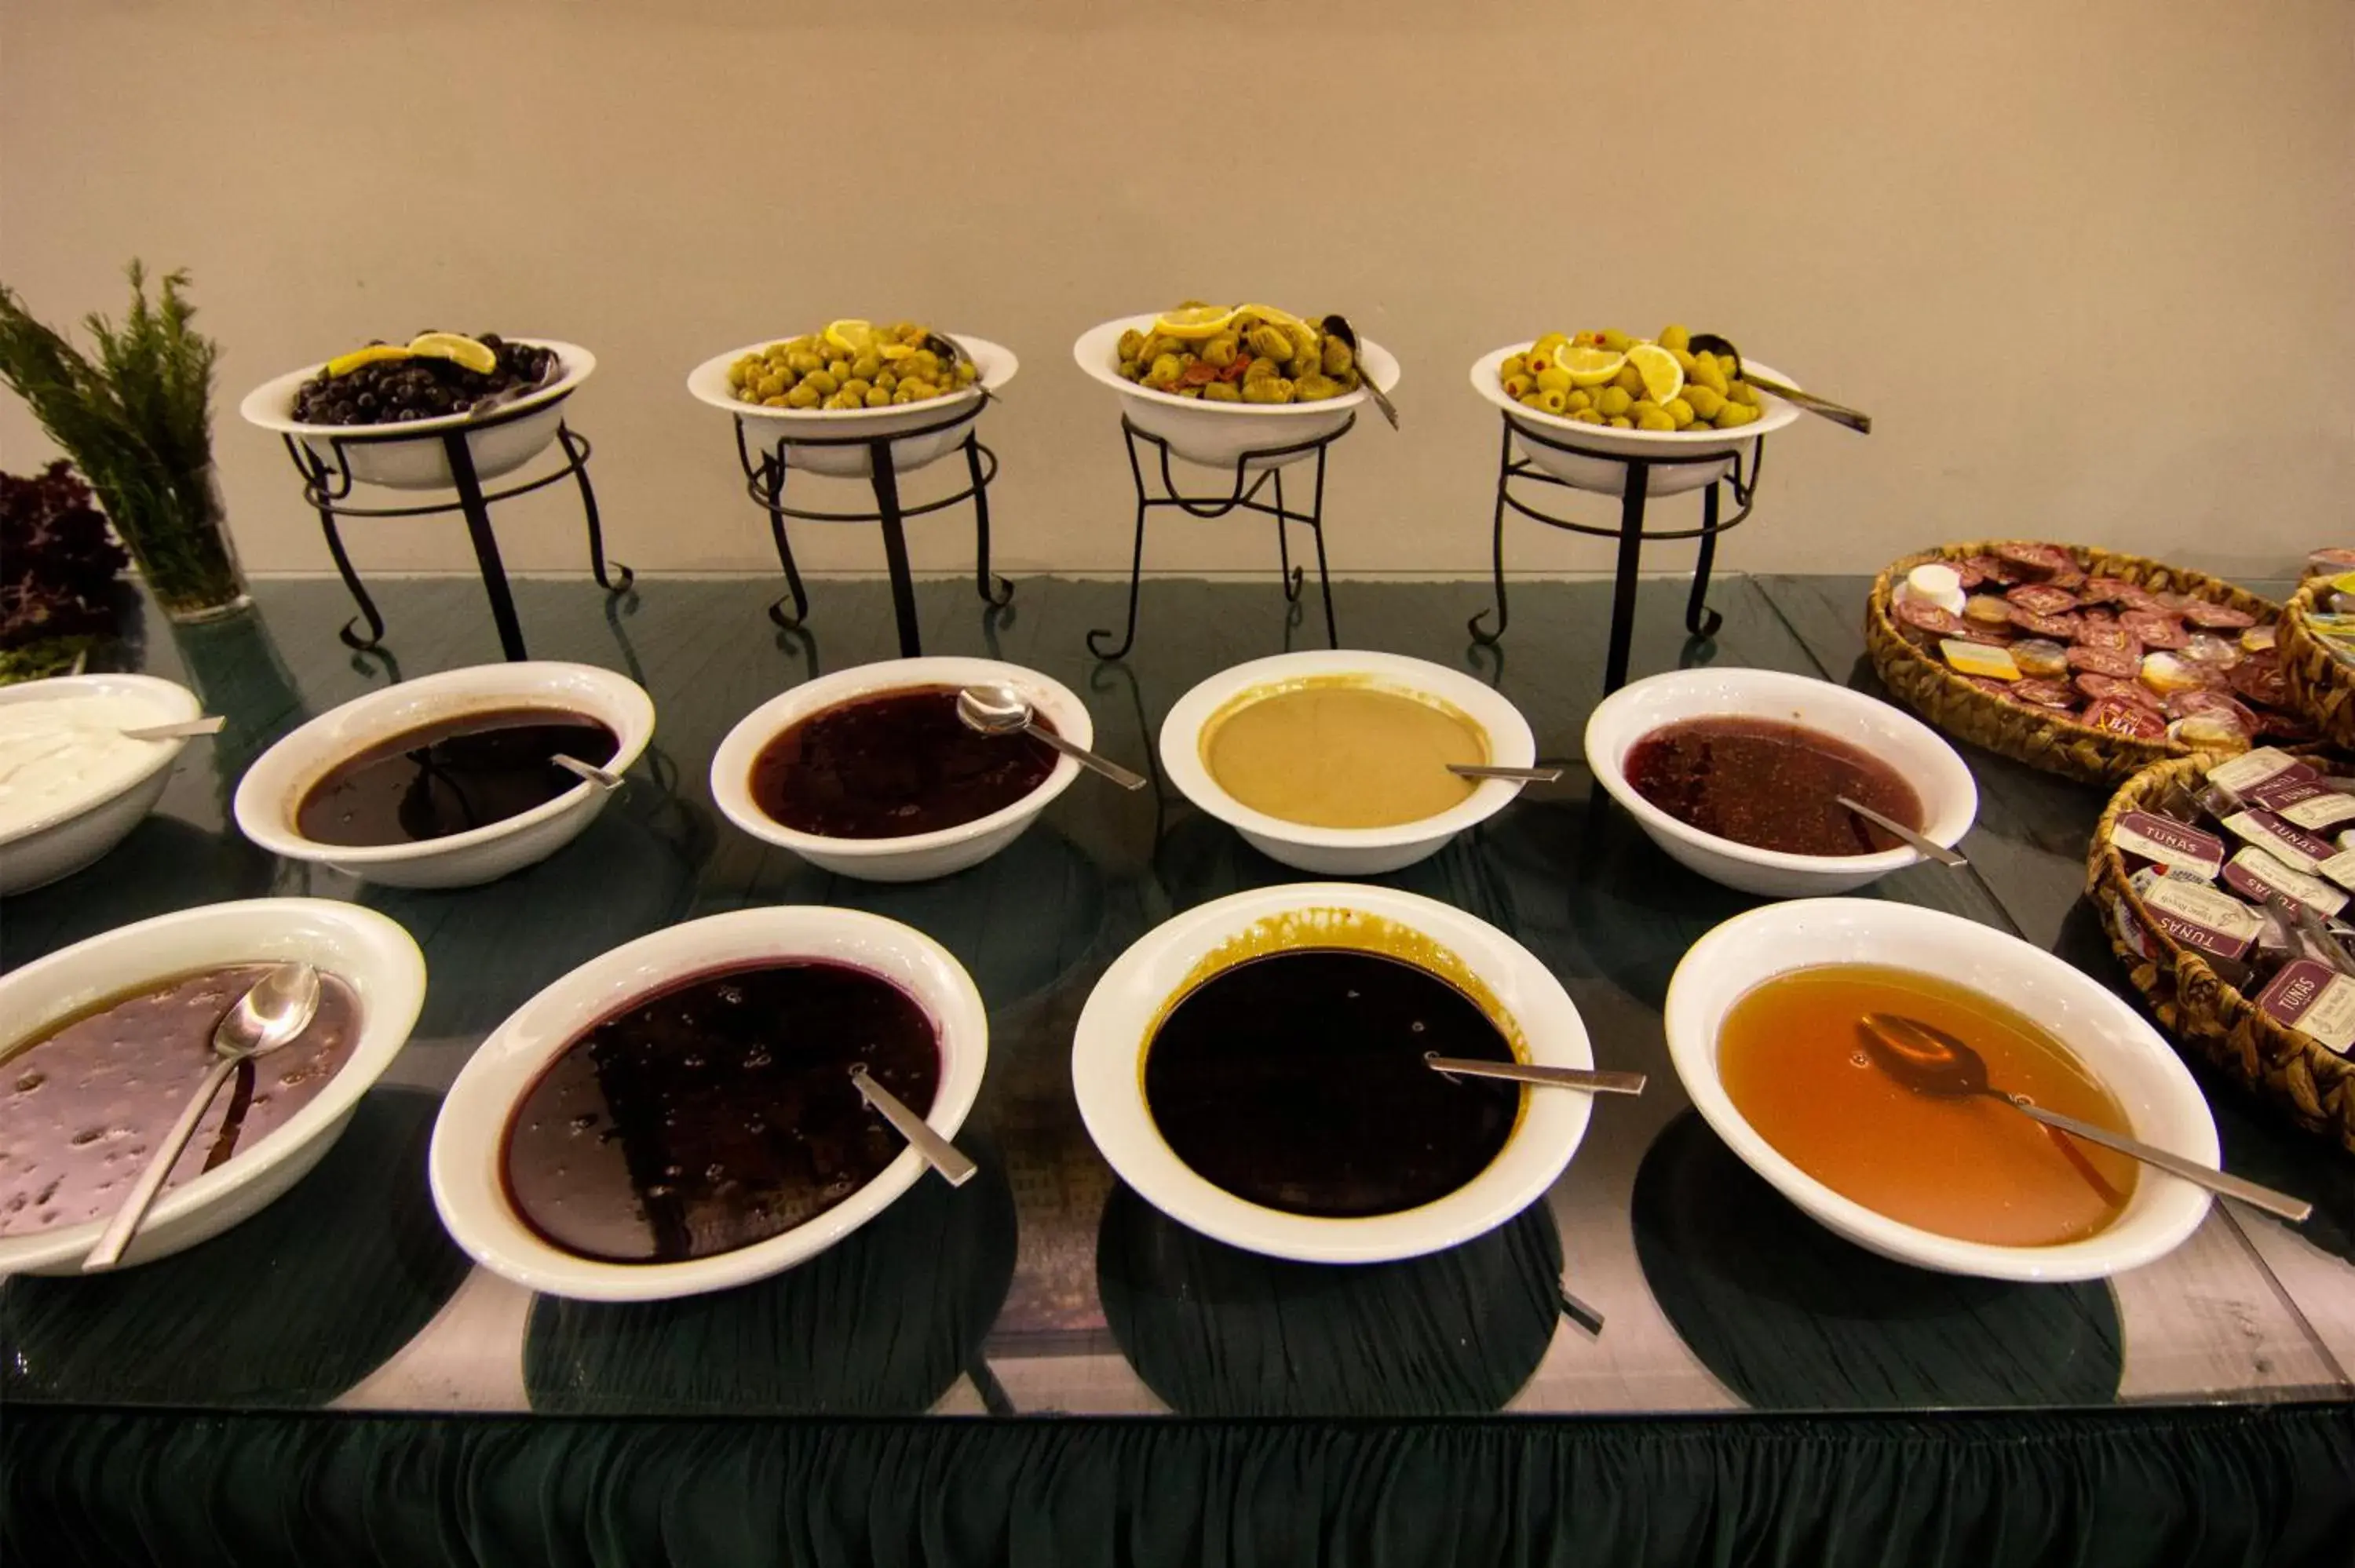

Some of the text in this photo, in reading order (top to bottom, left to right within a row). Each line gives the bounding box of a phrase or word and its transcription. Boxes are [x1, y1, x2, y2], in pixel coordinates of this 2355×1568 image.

[2147, 826, 2197, 853] TUNAS
[2271, 822, 2320, 854] TUNAS
[2160, 917, 2214, 947] TUNAS
[2278, 976, 2316, 1011] TUNAS
